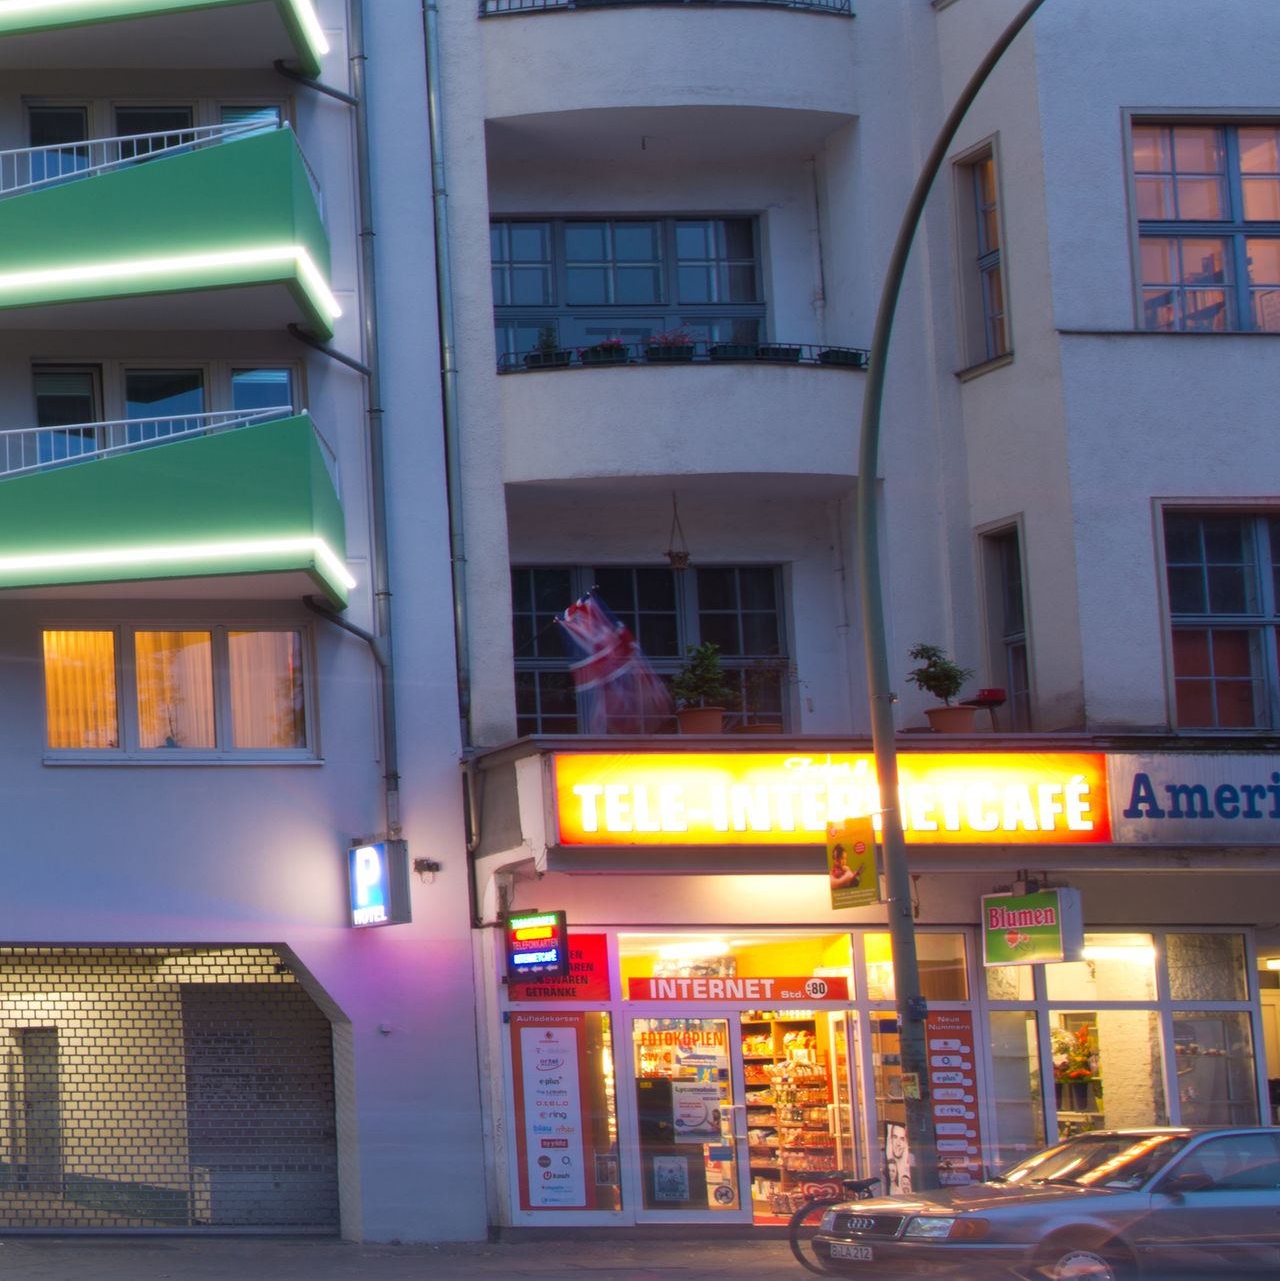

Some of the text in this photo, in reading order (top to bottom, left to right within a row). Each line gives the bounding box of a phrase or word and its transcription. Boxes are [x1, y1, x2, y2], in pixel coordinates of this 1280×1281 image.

[355, 846, 381, 906] P
[354, 905, 387, 925] HOTEL
[989, 906, 1056, 929] Blumen
[650, 978, 775, 999] INTERNET
[780, 990, 806, 999] Std.
[640, 1031, 723, 1046] FOTOKOPIEN
[831, 1245, 871, 1259] B LA 212
